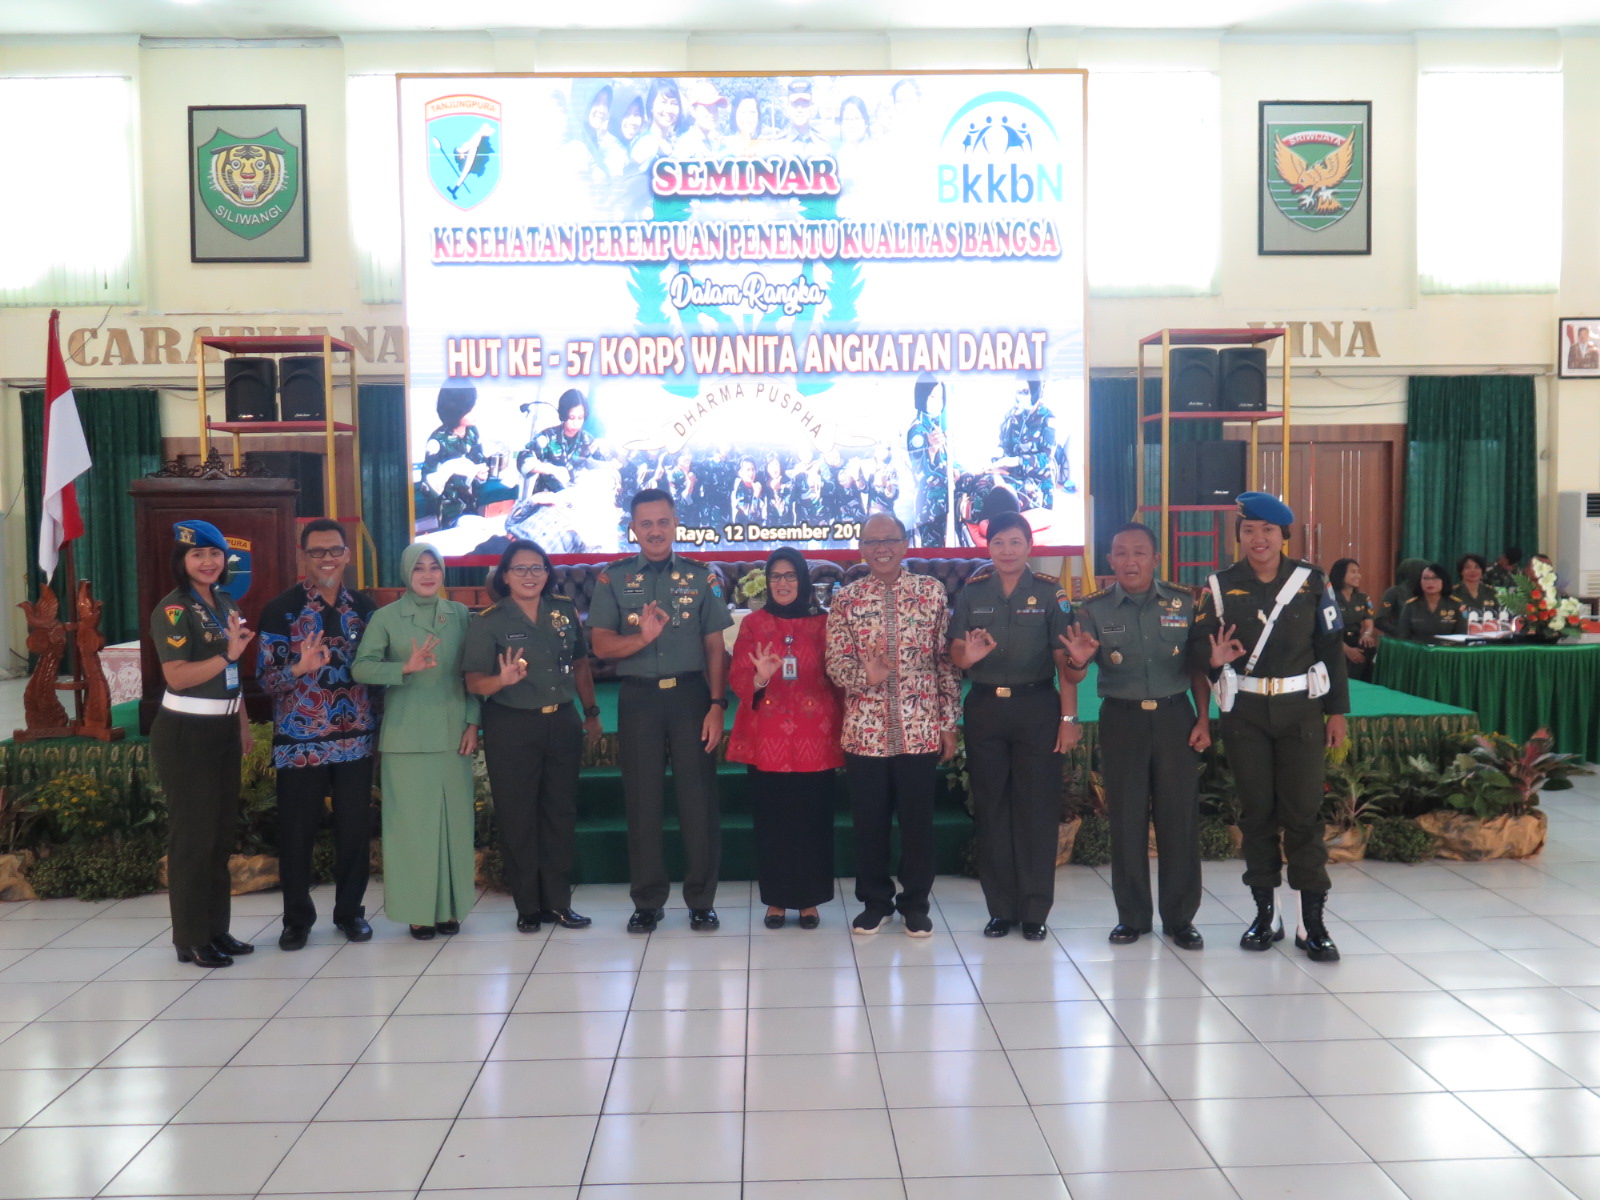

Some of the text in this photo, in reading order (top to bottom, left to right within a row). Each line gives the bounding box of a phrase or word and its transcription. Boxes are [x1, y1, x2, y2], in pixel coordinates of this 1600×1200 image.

[431, 100, 496, 113] TANJUNGPURA
[653, 159, 840, 194] SEMINAR
[937, 163, 1063, 203] BkkbN
[215, 204, 283, 225] SILIWANGI
[433, 220, 1058, 259] KESEHATAN PEREMPUAN PENENTU KUALITAS BANGSA
[670, 271, 826, 316] Dalam Rangka
[447, 337, 501, 377] HUT
[507, 336, 543, 376] KE
[565, 341, 595, 376] 57
[600, 335, 686, 376] KORPS
[691, 334, 799, 375] WANITA
[803, 333, 952, 374] ANGKATAN
[957, 331, 1048, 371] DARAT
[673, 382, 822, 438] DHARMA PUSPHA
[675, 522, 862, 545] Raya, 12 Desember 201
[1323, 605, 1338, 630] P
